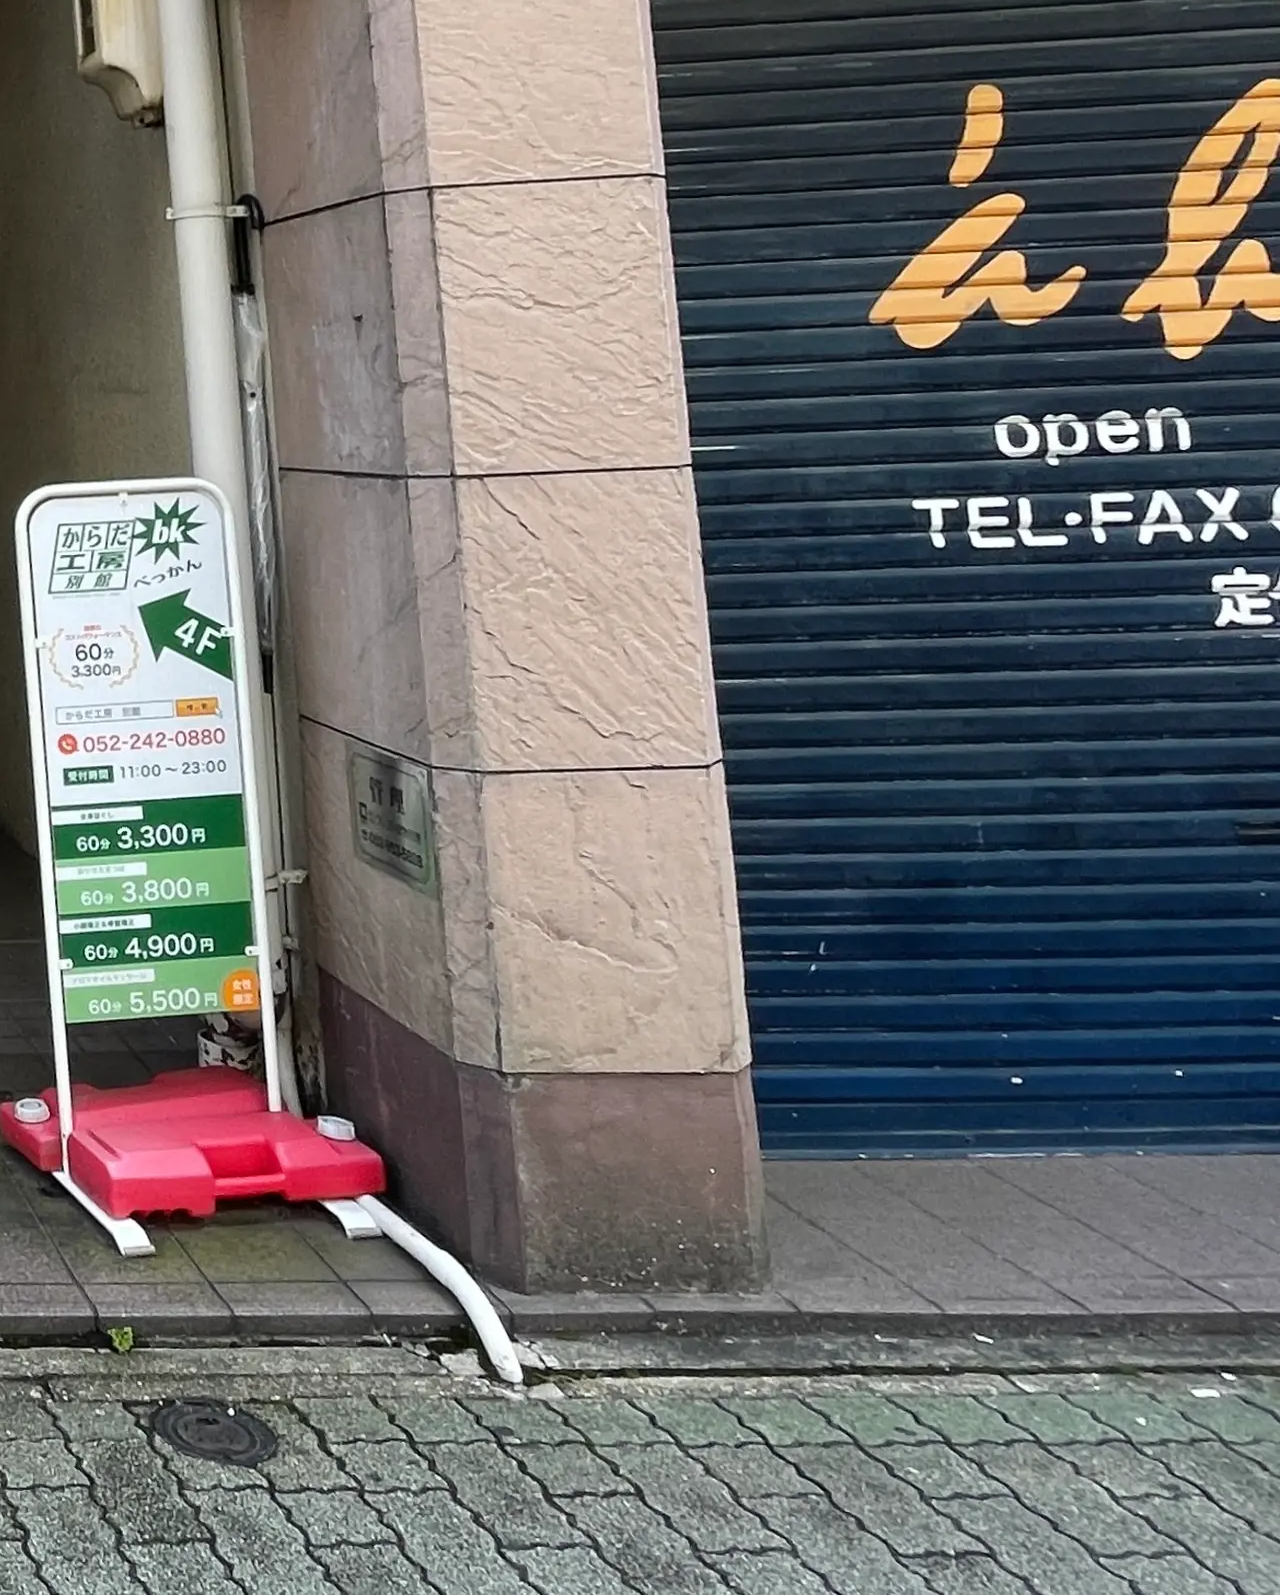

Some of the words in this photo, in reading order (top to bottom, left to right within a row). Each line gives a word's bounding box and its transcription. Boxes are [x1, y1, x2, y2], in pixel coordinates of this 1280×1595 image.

[993, 405, 1193, 467] open
[62, 523, 130, 549] からだ
[151, 518, 185, 544] bk
[56, 551, 126, 571] 工房
[133, 559, 203, 589] べっかん
[1211, 566, 1280, 628] 定
[174, 617, 222, 657] 4F
[75, 643, 114, 662] 60分
[83, 727, 226, 753] 052-242-0880
[76, 835, 111, 852] 60分
[116, 823, 206, 850] 3,300円
[80, 890, 114, 906] 60分
[121, 877, 210, 904] 3,800円
[84, 943, 119, 961] 60分
[124, 932, 214, 960] 4,900円
[88, 998, 122, 1015] 60分
[129, 987, 218, 1014] 5,500円
